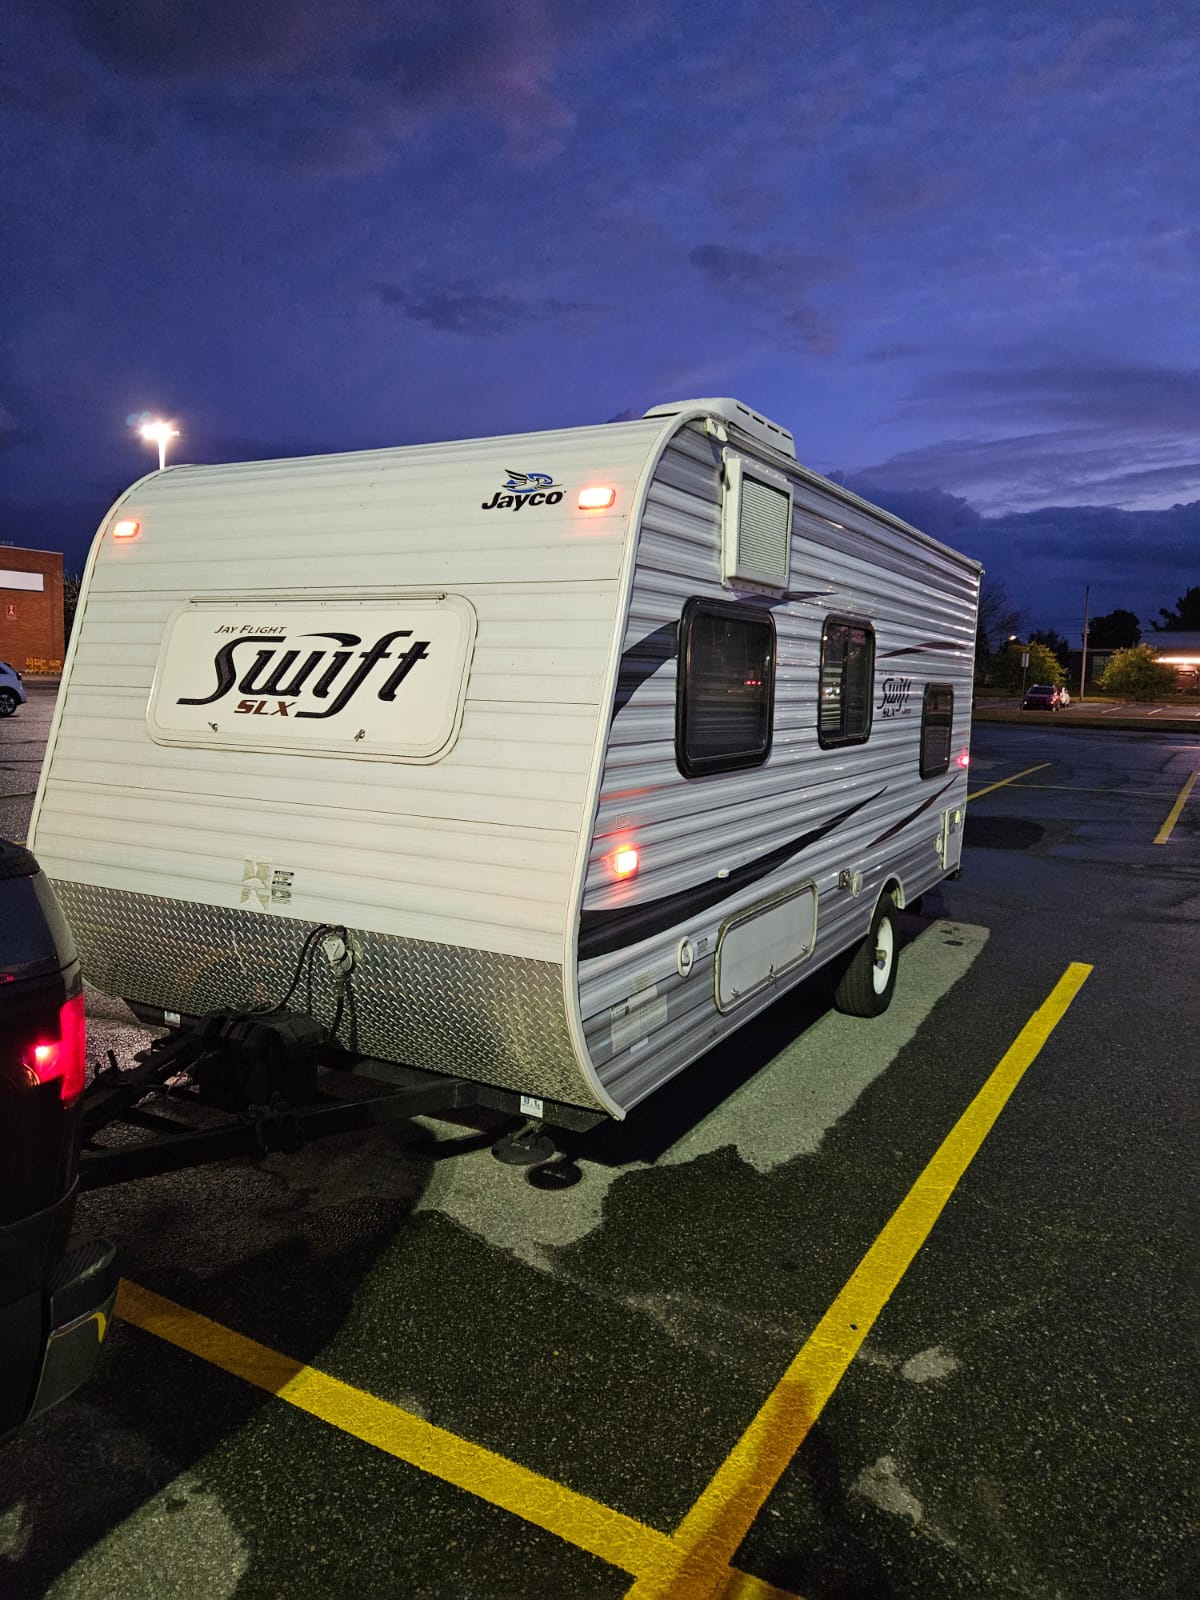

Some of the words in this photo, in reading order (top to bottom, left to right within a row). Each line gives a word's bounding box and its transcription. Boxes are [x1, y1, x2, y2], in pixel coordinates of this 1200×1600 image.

[481, 491, 563, 512] Jayco
[176, 630, 431, 719] Swift
[233, 699, 297, 717] SLX
